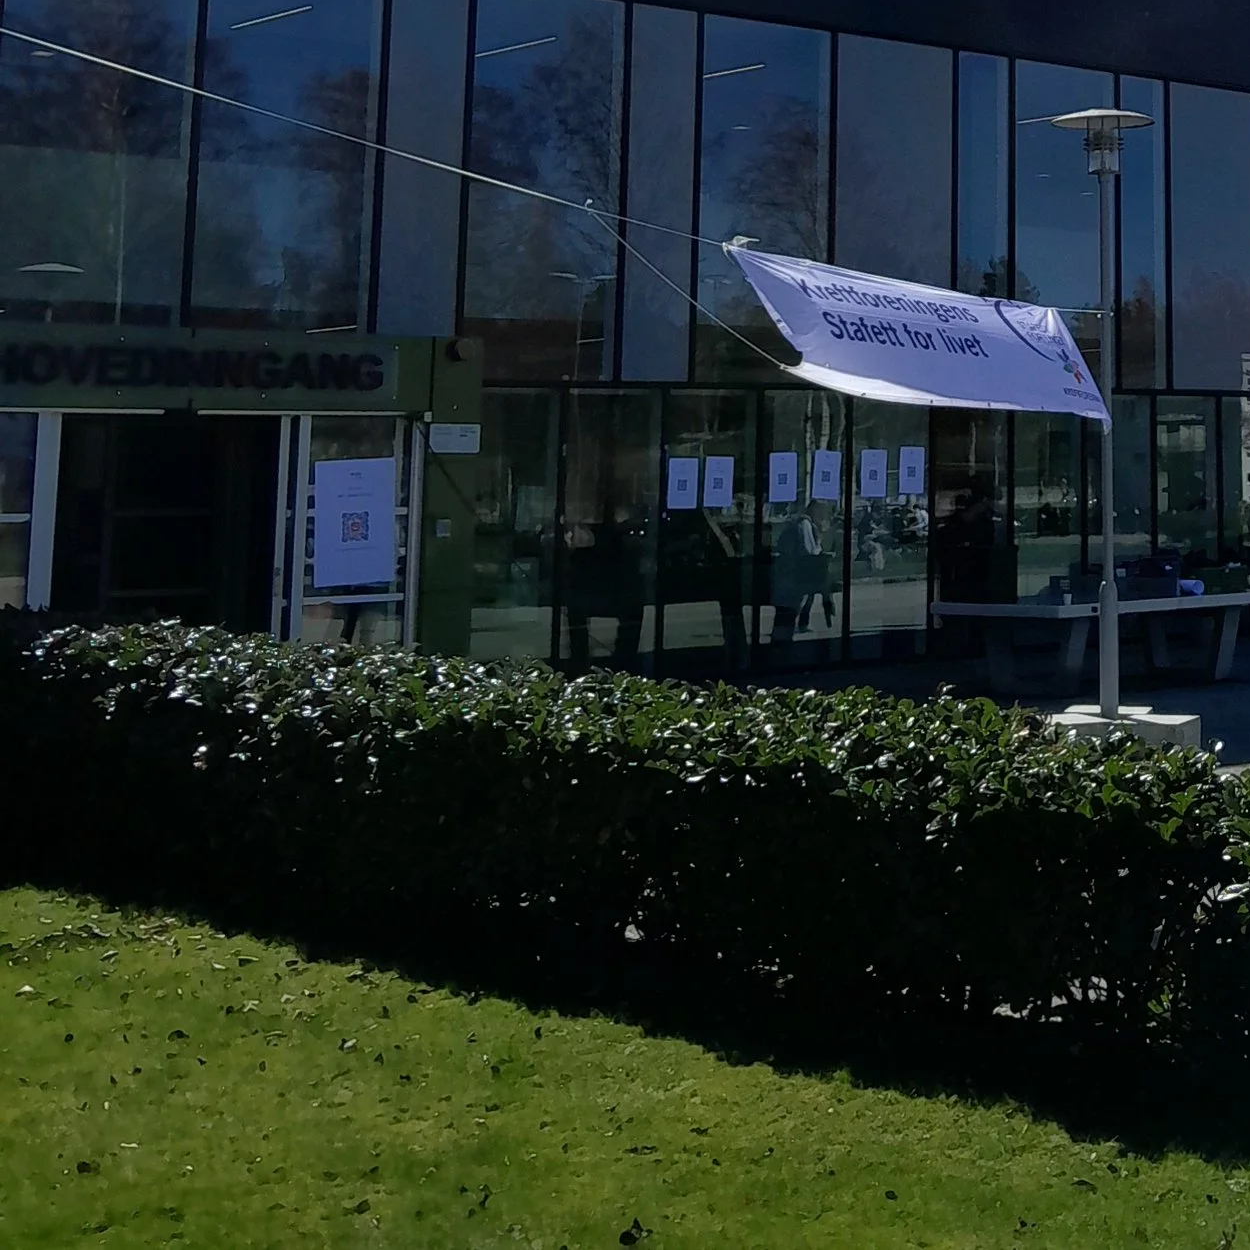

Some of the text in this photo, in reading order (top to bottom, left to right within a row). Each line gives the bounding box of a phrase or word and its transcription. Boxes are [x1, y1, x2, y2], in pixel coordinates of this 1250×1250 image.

[799, 277, 980, 324] Kreftforeningens
[822, 310, 902, 347] Stafett
[903, 321, 938, 352] for
[940, 328, 990, 359] livet
